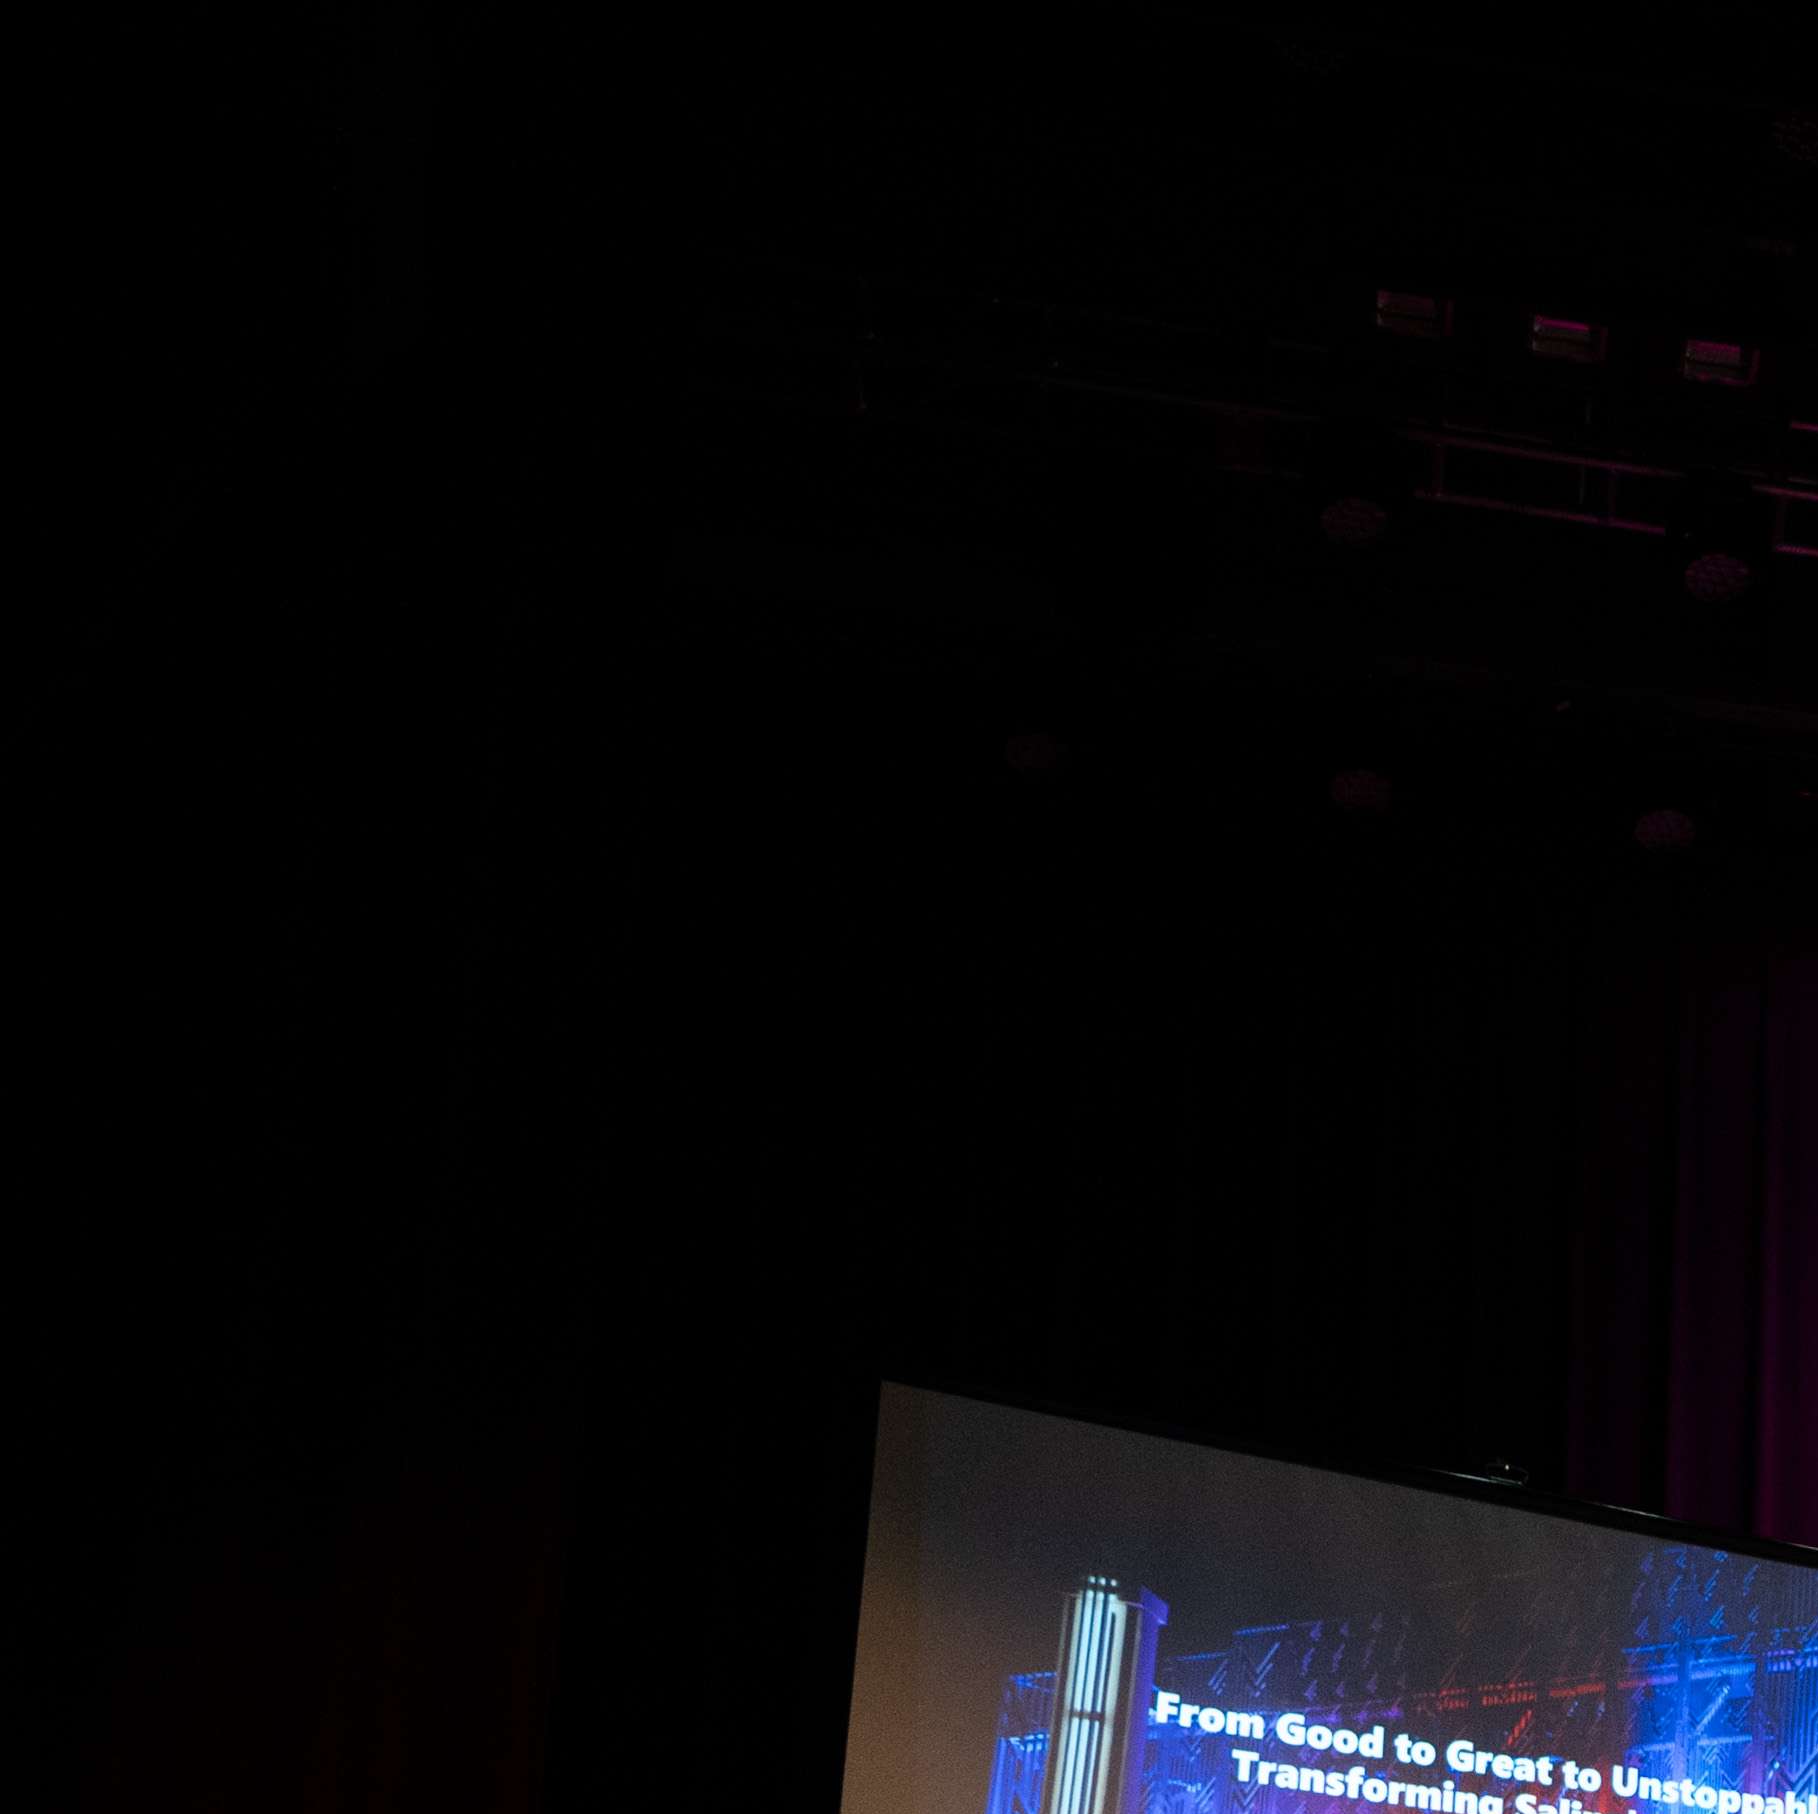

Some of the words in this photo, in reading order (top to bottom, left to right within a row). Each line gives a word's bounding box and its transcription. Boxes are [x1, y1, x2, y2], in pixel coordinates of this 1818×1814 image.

[1155, 1691, 1264, 1739] From
[1276, 1712, 1384, 1758] Good
[1394, 1733, 1436, 1766] to
[1446, 1740, 1553, 1787] Great
[1562, 1760, 1601, 1792] to
